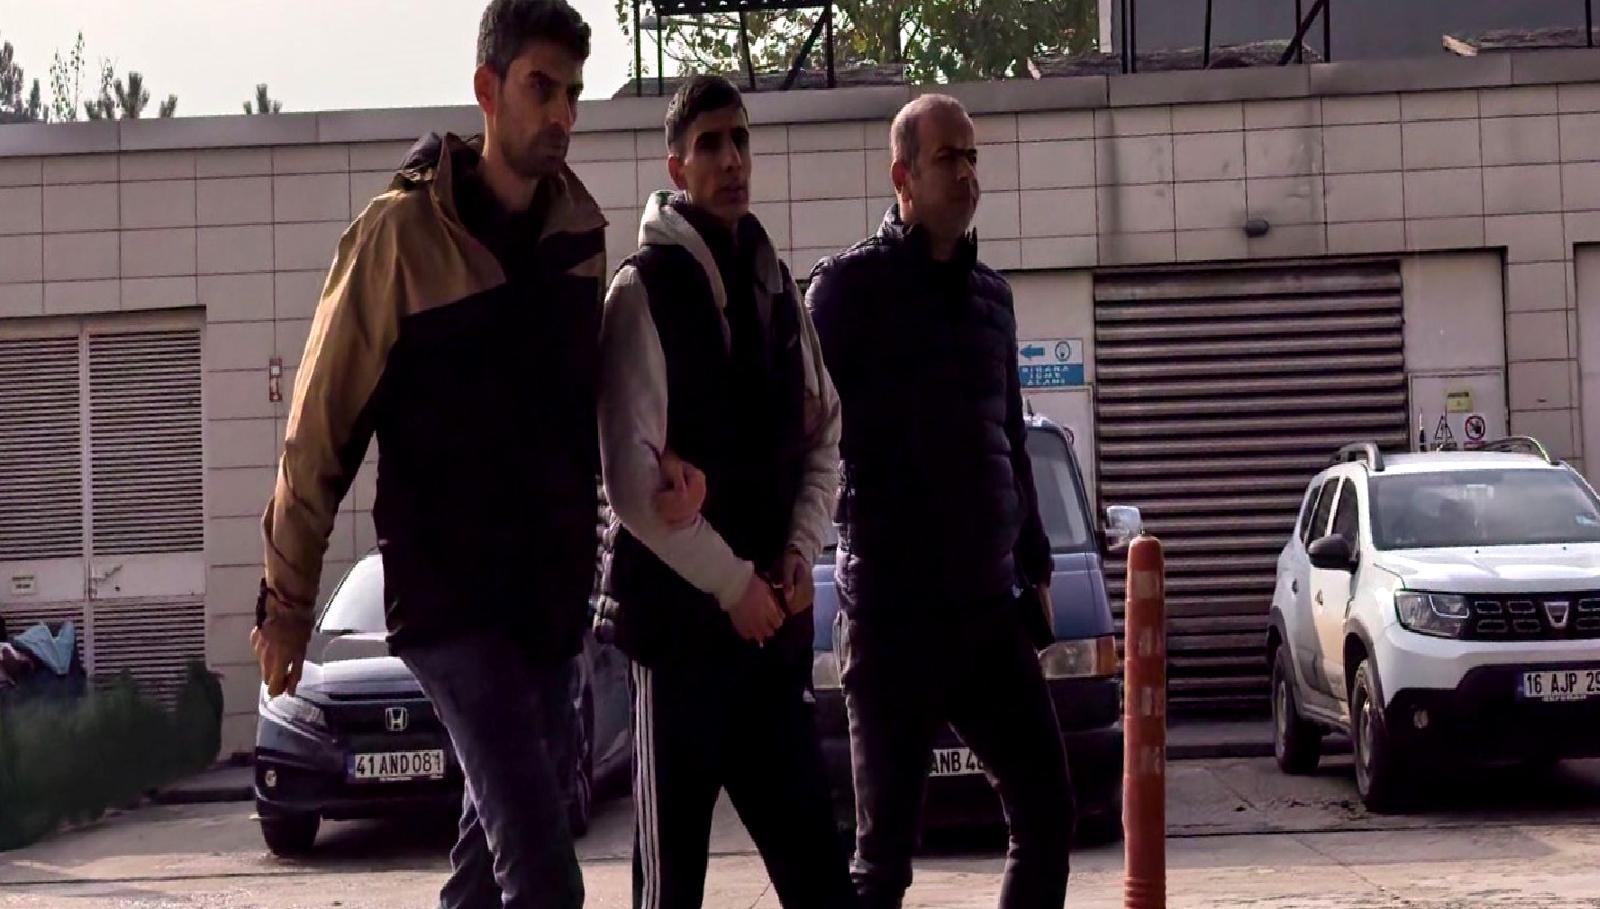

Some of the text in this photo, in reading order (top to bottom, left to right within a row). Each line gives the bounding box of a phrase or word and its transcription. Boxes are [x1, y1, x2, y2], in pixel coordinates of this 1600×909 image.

[1527, 673, 1542, 694] 16
[1551, 673, 1577, 693] AJP
[356, 752, 441, 775] 41 AND 081
